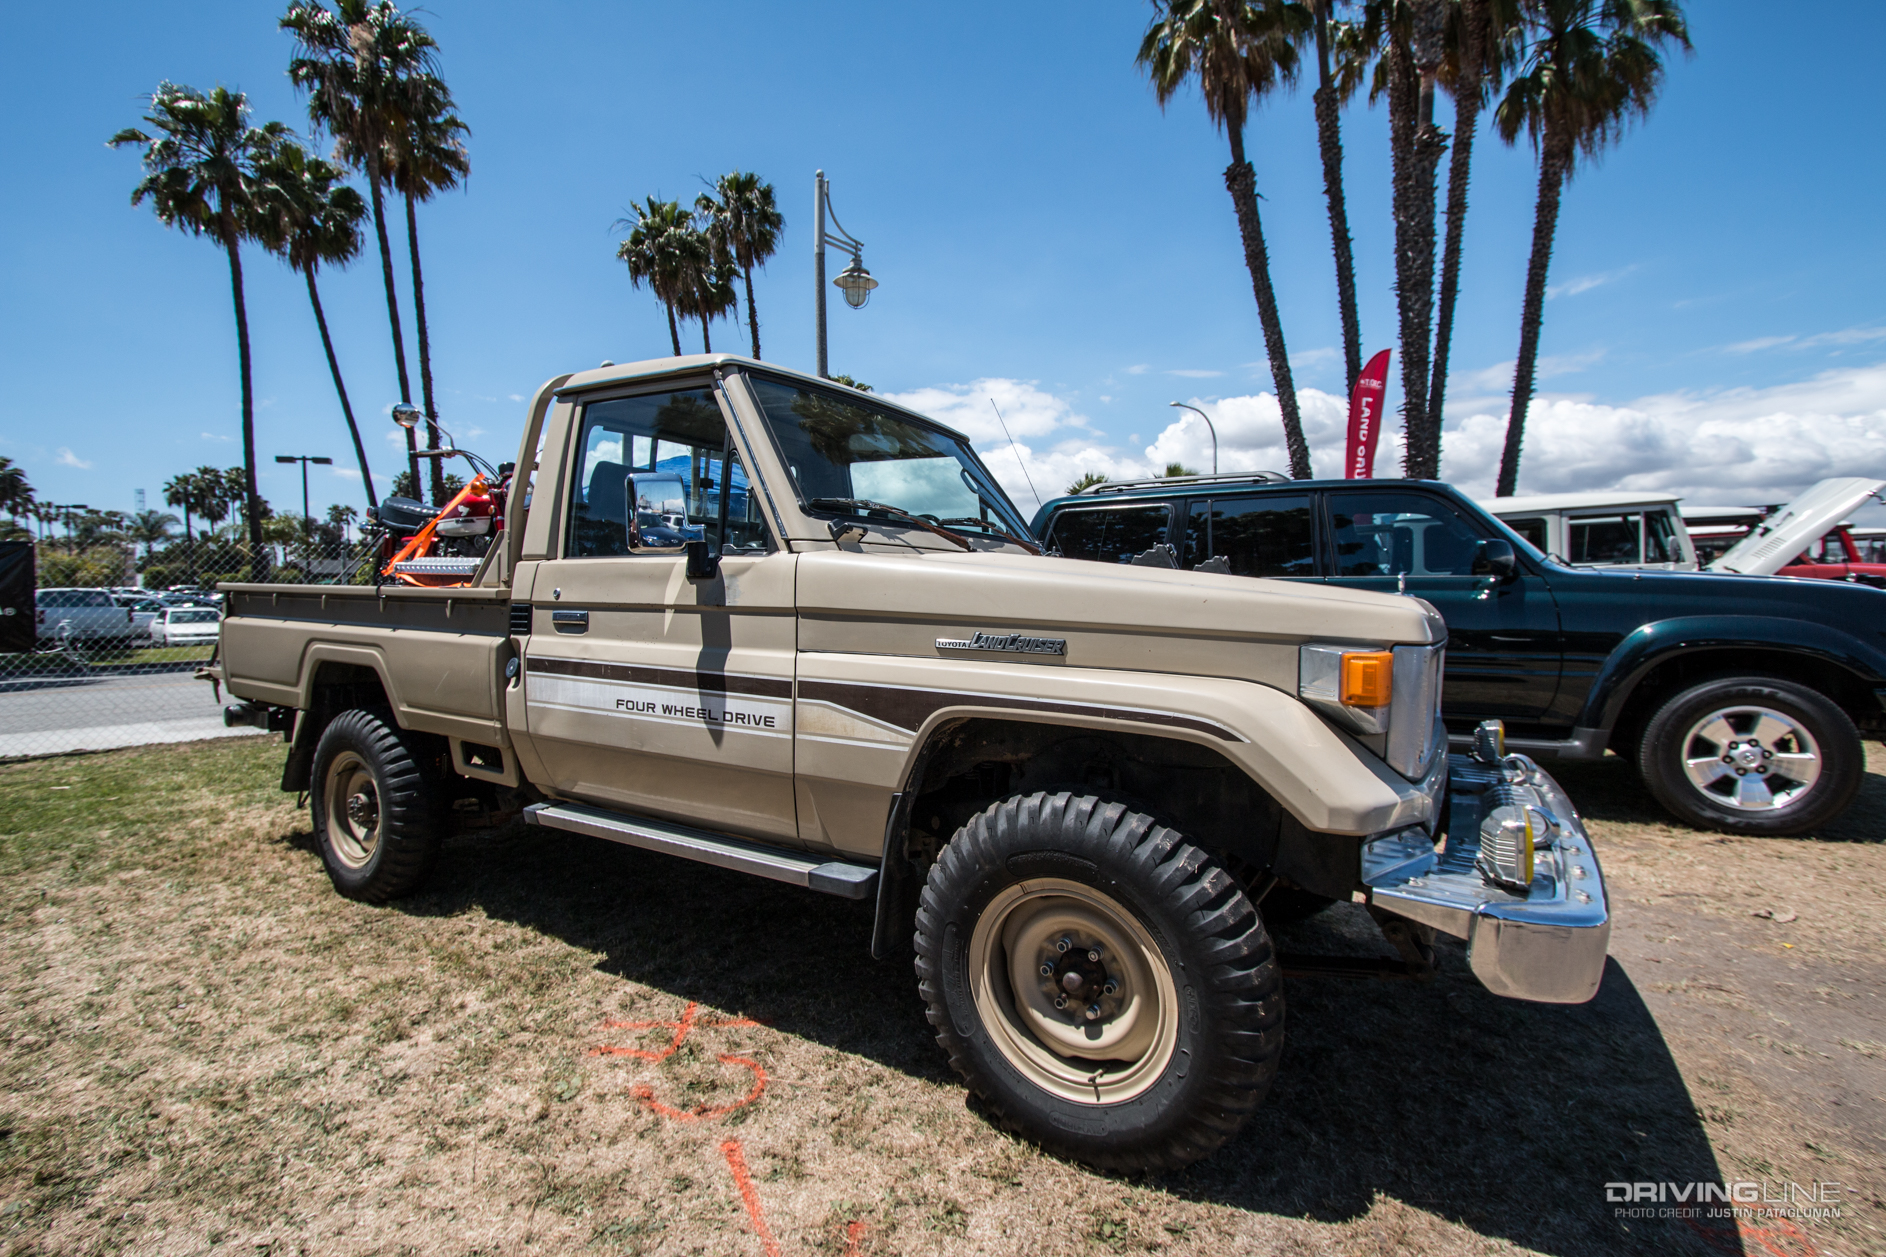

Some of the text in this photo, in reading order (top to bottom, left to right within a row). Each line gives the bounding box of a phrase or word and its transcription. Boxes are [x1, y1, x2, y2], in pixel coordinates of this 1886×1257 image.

[1359, 397, 1373, 442] LAND
[937, 640, 968, 648] TOYOTA
[616, 699, 775, 728] FOUR WHEEL DRIVE
